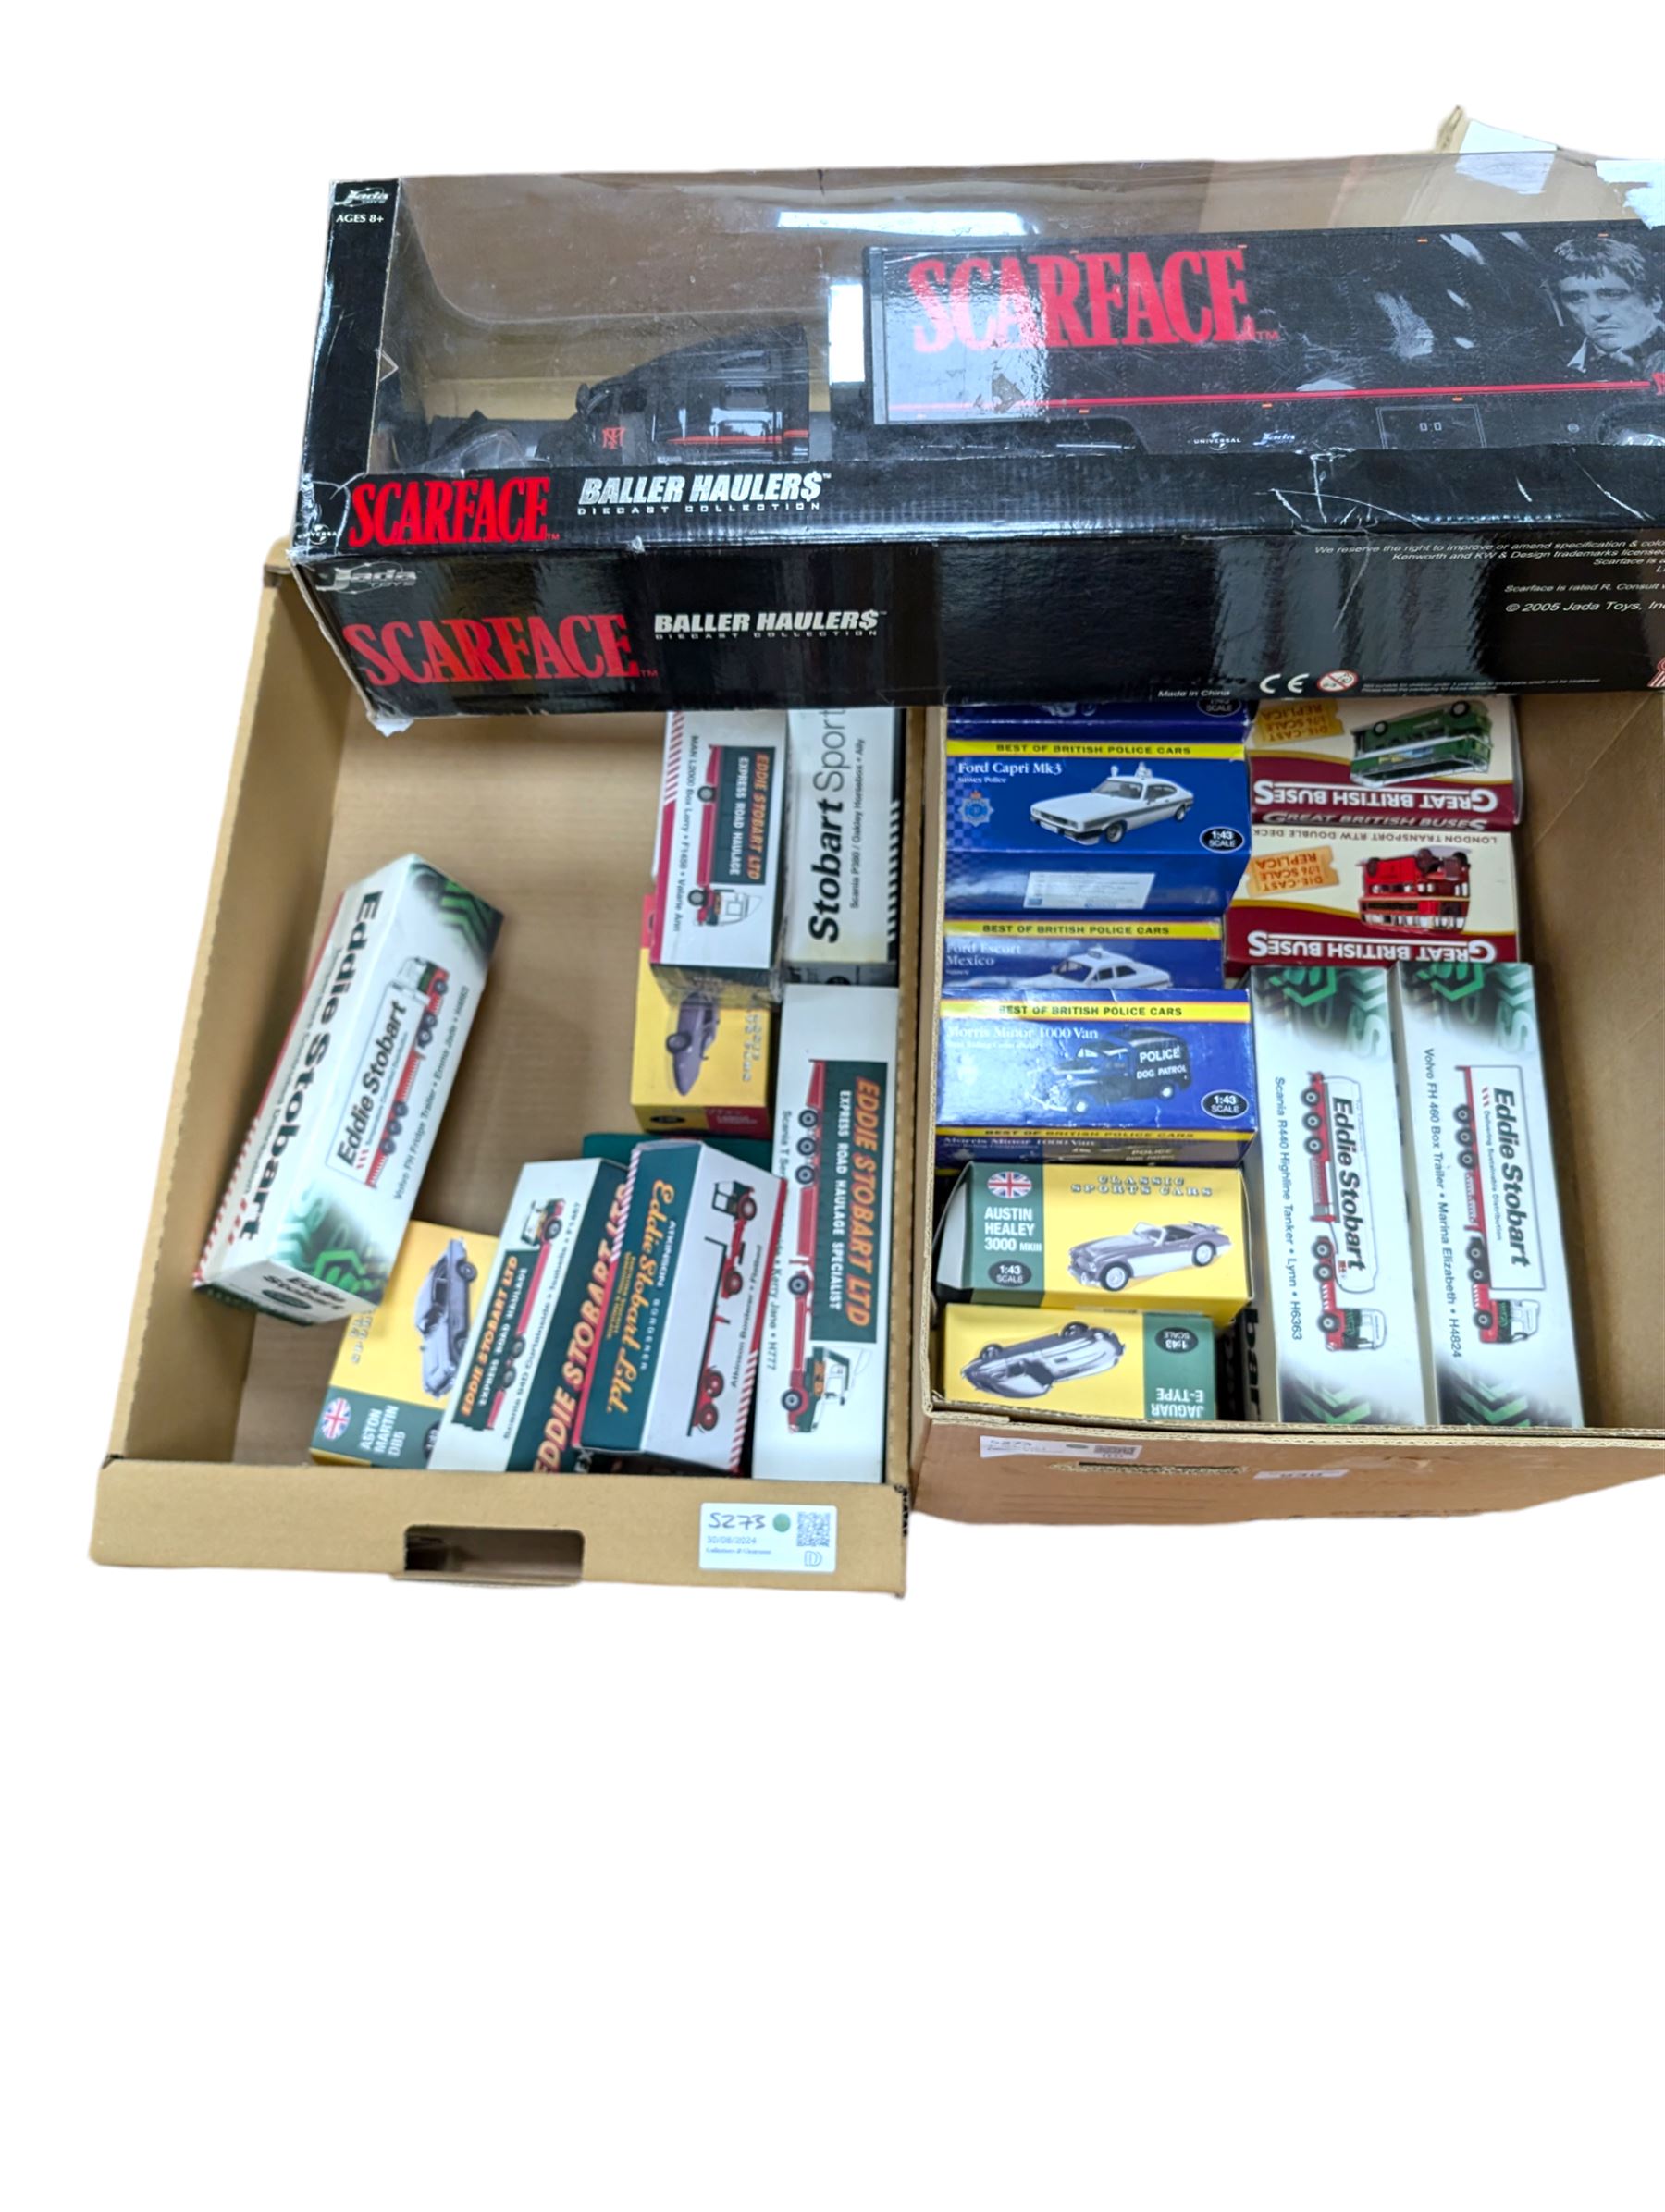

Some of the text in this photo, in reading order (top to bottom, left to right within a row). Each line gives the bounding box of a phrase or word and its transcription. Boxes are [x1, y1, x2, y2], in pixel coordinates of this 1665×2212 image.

[336, 214, 385, 223] AGES 8+
[908, 249, 1255, 353] SCARFACE
[578, 471, 823, 506] BALLER HAULER$
[348, 476, 550, 548] SCARFACE
[577, 501, 820, 516] DIECAST COLLECTION
[1391, 553, 1447, 561] Kenworth
[1474, 551, 1498, 559] KW
[1510, 550, 1551, 560] Design
[1552, 549, 1619, 558] trademarks
[1404, 544, 1430, 554] right
[1446, 544, 1495, 554] improve
[1511, 541, 1553, 550] amend
[1554, 540, 1626, 550] specification
[1593, 558, 1645, 566] Scarface
[316, 567, 418, 592] Jada
[1504, 584, 1554, 594] Scarface
[1568, 583, 1598, 592] rated
[1522, 601, 1643, 612] 2005 Jada Toys,
[654, 608, 880, 633] BALLER HAULER$
[753, 629, 878, 639] COLLECTION
[342, 614, 641, 687] SCARFACE
[1157, 688, 1231, 698] Made China
[996, 743, 1191, 756] BEST OF BRITISH POLICE CARS
[957, 763, 1062, 777] Ford Capri Mk3
[1252, 780, 1498, 812] GREAT BRITISH BUSES
[728, 756, 749, 876] EXPRESS ROAD HAULAGE
[746, 753, 769, 880] EDDIE STOBART LTD
[1262, 811, 1487, 831] GREAT BRITISH BUSES
[1208, 839, 1237, 848] SCALE
[1211, 830, 1234, 841] 1:43
[1289, 830, 1498, 844] LONDON TRANSPORT RTW DOUBLE
[1255, 852, 1317, 870] REPLICA
[807, 797, 844, 943] Stobart
[1263, 875, 1324, 892] DIE-CAST
[849, 876, 860, 909] Scania
[982, 925, 1170, 935] BEST OF BRITISH POLICE CARS
[945, 943, 1022, 955] Ford Escort
[1247, 930, 1497, 964] GREAT BRITISH BUSES
[945, 955, 995, 966] Mexico
[1032, 1005, 1047, 1015] OF
[1052, 1006, 1100, 1016] BRITISH
[1103, 1006, 1146, 1016] POLICE
[1149, 1007, 1182, 1016] CARS
[1039, 1026, 1099, 1040] 1000 Van
[1139, 1047, 1181, 1063] POLICE
[239, 889, 384, 1241] Eddie Stobart
[1137, 1064, 1187, 1080] DOG PATROL
[336, 999, 407, 1168] Eddie Stobart
[1211, 1103, 1240, 1113] SCALE
[1213, 1095, 1238, 1105] 1:43
[1096, 1174, 1186, 1186] CLASSIC
[1332, 1095, 1366, 1272] Eddie Stobart
[1492, 1085, 1532, 1269] Eddie Stobart
[1070, 1184, 1214, 1198] SPORTS CARS
[828, 1089, 852, 1311] EXPRESS ROAD HAULAGE SPECIALIST
[844, 1075, 882, 1328] EDDIE STOBART LTD
[1274, 1075, 1302, 1340] Scania R440 Highline Tanker Lynn H6363
[1423, 1047, 1462, 1358] Volvo FH 460 Box Trailer Marina Elizabeth H4824
[640, 1178, 676, 1255] Eddie
[984, 1207, 1034, 1221] AUSTIN
[984, 1223, 1036, 1237] HEALEY
[984, 1237, 1017, 1252] 3000
[998, 1264, 1022, 1275] 1:43
[995, 1273, 1024, 1284] SCALE
[620, 1253, 659, 1349] Stobart
[562, 1239, 614, 1392] STOBART
[462, 1255, 519, 1417] EDDIE STOBART LTD
[638, 1296, 660, 1371] BORDERER
[1165, 1339, 1188, 1350] 1:43
[478, 1358, 501, 1407] EXPRESS
[496, 1321, 512, 1357] ROAD
[605, 1347, 641, 1417] Ltd.
[1156, 1387, 1204, 1402] E-TYPE
[1150, 1402, 1204, 1419] JAGUAR
[359, 1408, 383, 1451] ASTON
[374, 1405, 400, 1455] MARTIN
